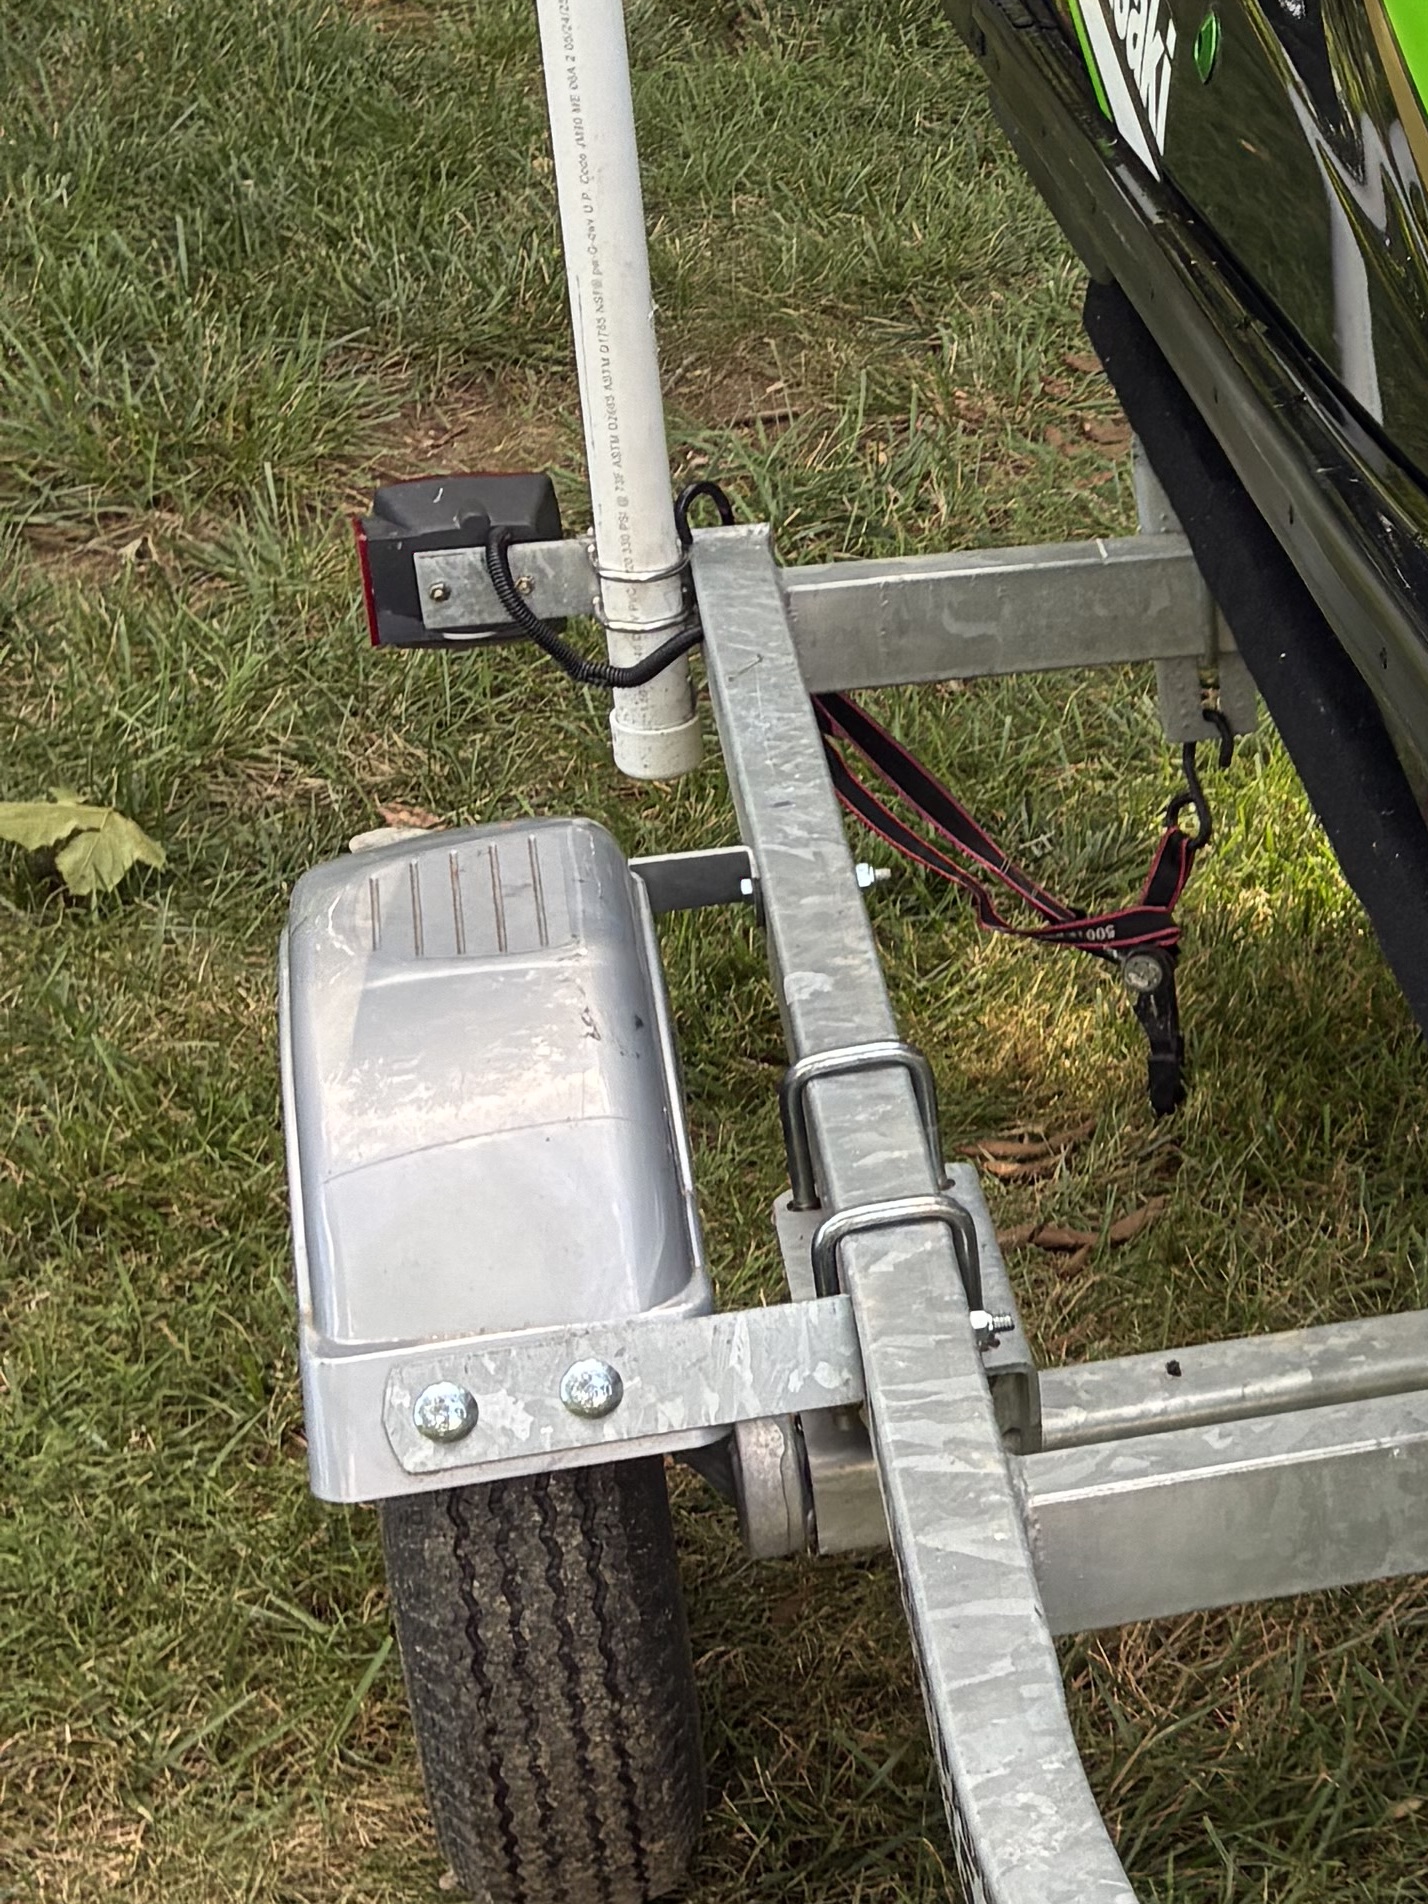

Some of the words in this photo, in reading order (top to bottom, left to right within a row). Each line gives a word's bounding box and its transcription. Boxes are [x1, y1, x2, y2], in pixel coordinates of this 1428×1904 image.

[576, 151, 589, 185] Code
[599, 356, 613, 392] ASTM
[608, 433, 621, 468] ASTM
[1085, 924, 1116, 941] 500
